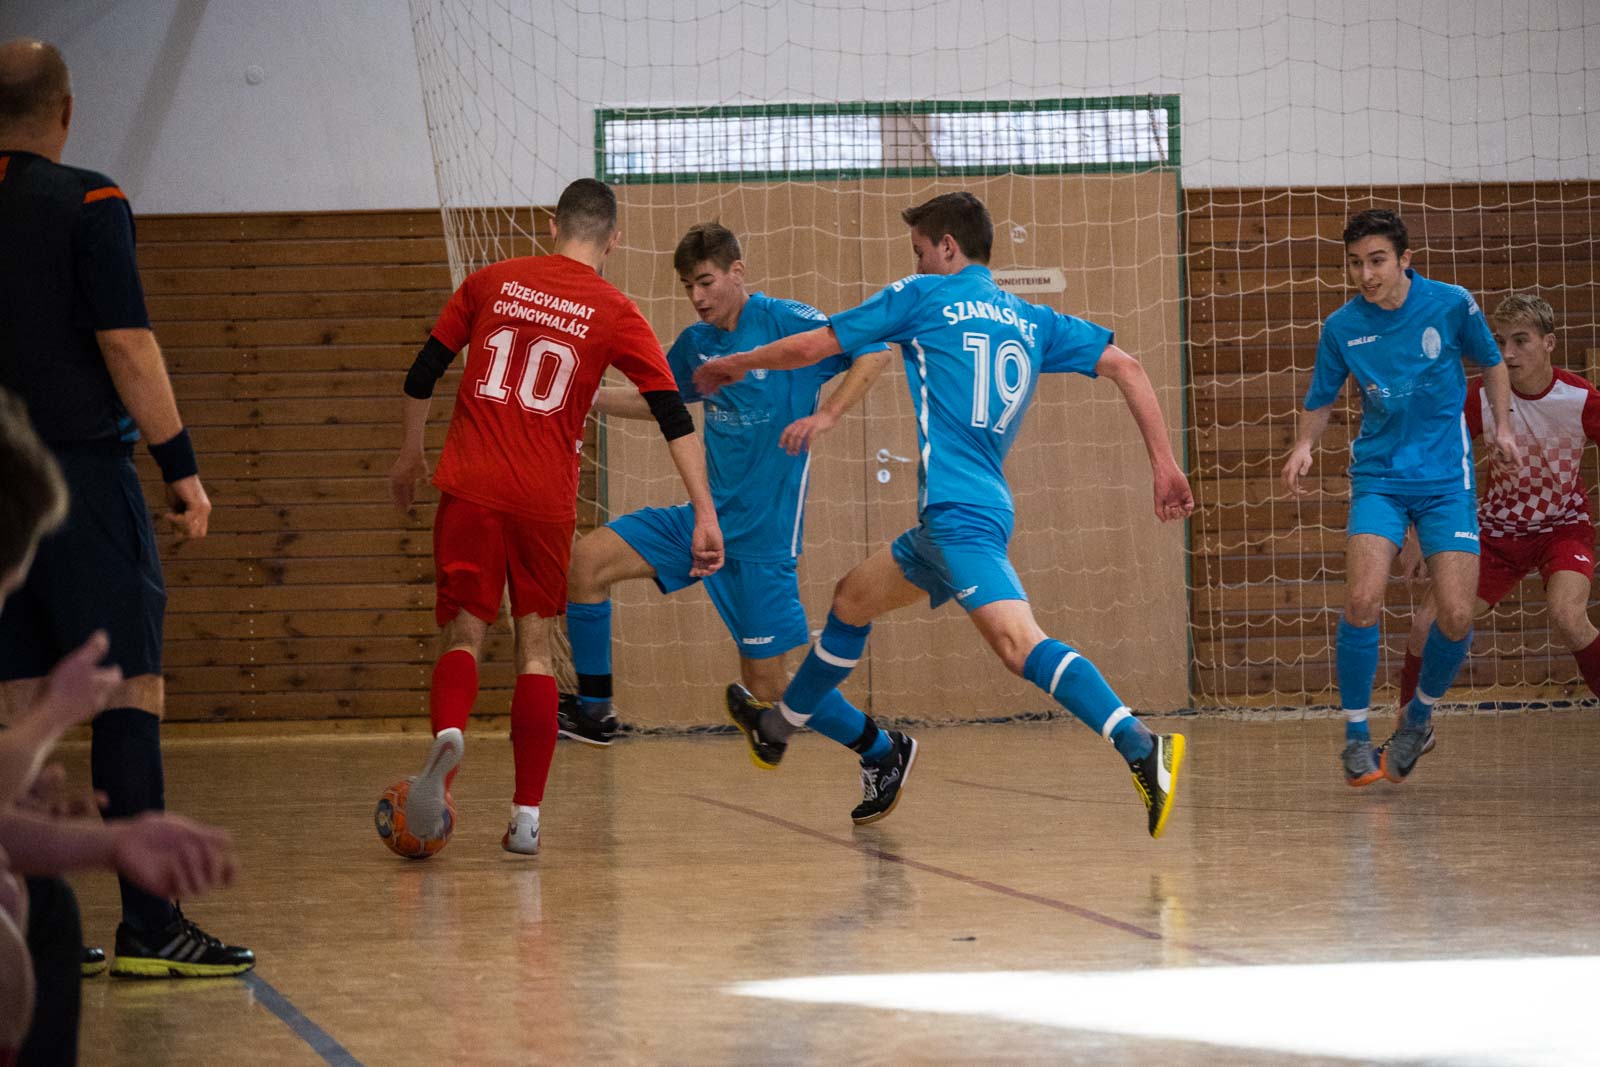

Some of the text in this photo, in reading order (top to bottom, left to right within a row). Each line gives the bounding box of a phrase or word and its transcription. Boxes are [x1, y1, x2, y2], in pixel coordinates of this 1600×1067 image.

[493, 300, 590, 339] GYÖNGYHALÁSZ
[500, 281, 596, 320] FÜZESGYARMAT
[474, 325, 581, 416] 10
[963, 332, 1032, 434] 19
